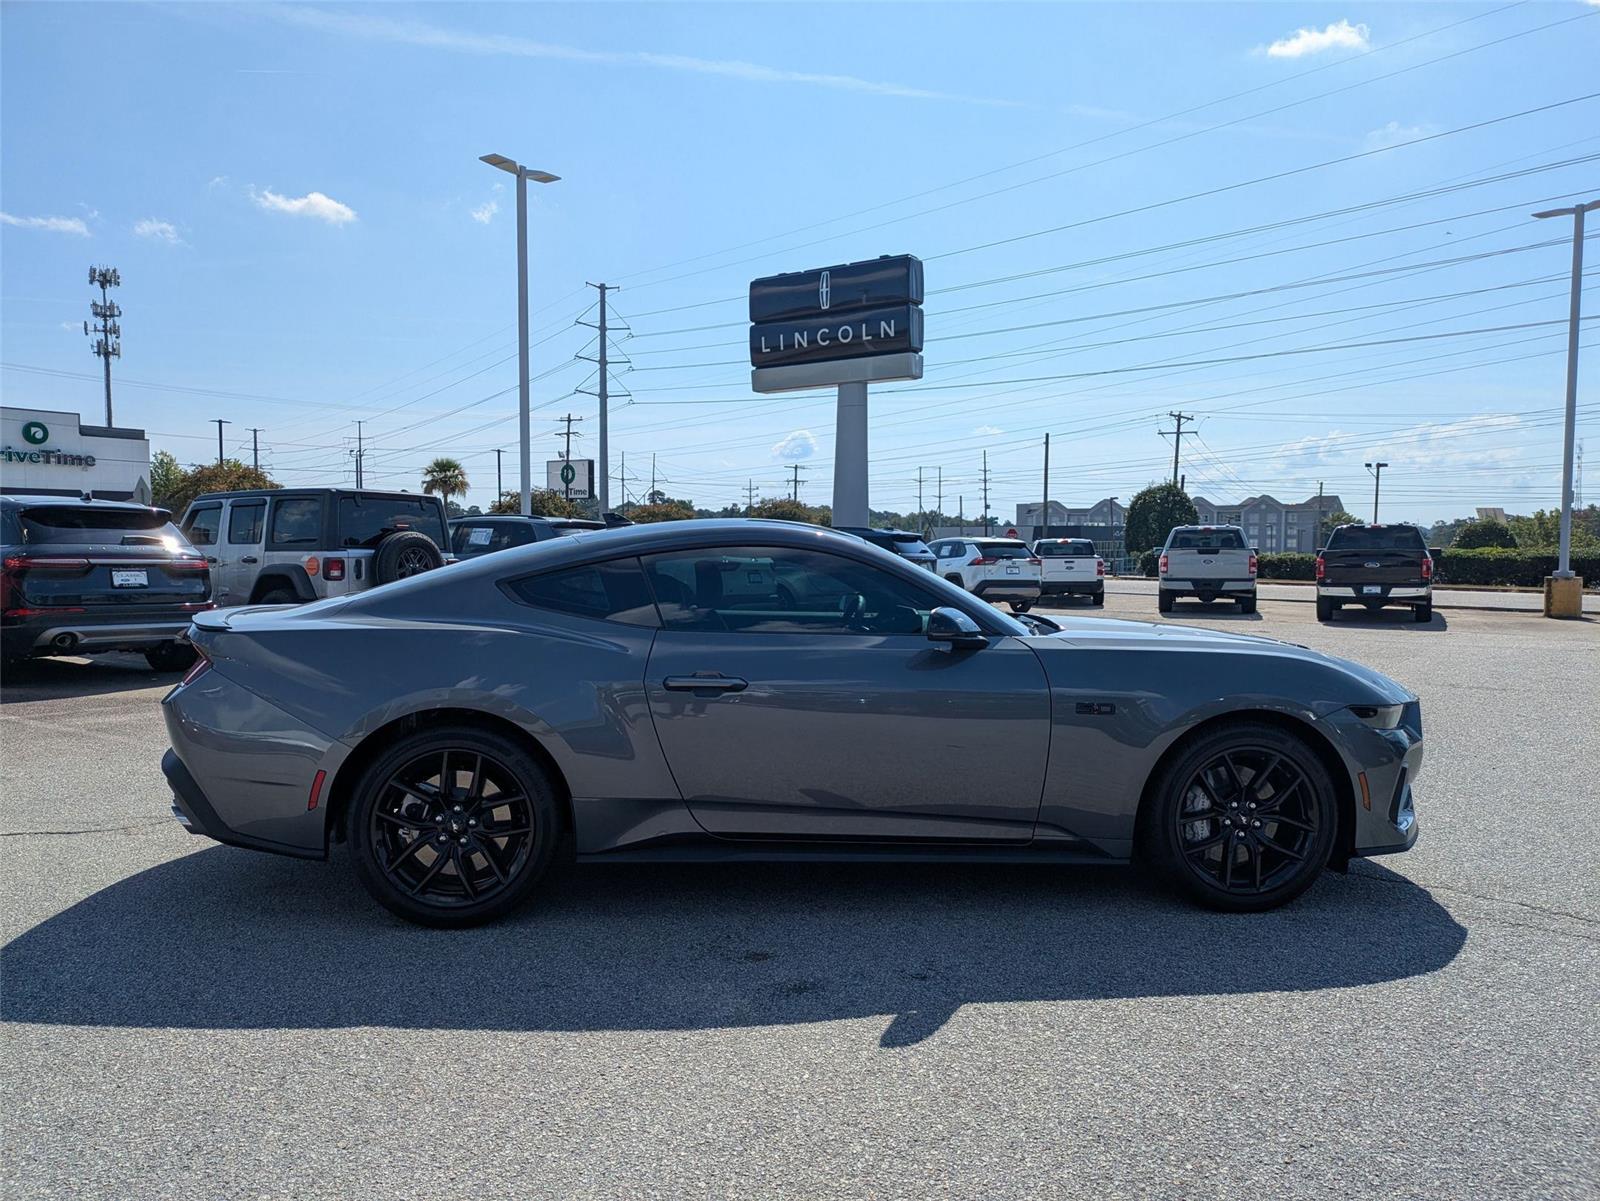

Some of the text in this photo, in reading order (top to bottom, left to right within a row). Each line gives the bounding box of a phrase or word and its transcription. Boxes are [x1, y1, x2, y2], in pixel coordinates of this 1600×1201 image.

[761, 319, 895, 353] LINCOLN
[0, 446, 96, 467] iveTime
[549, 487, 588, 496] DrivTime
